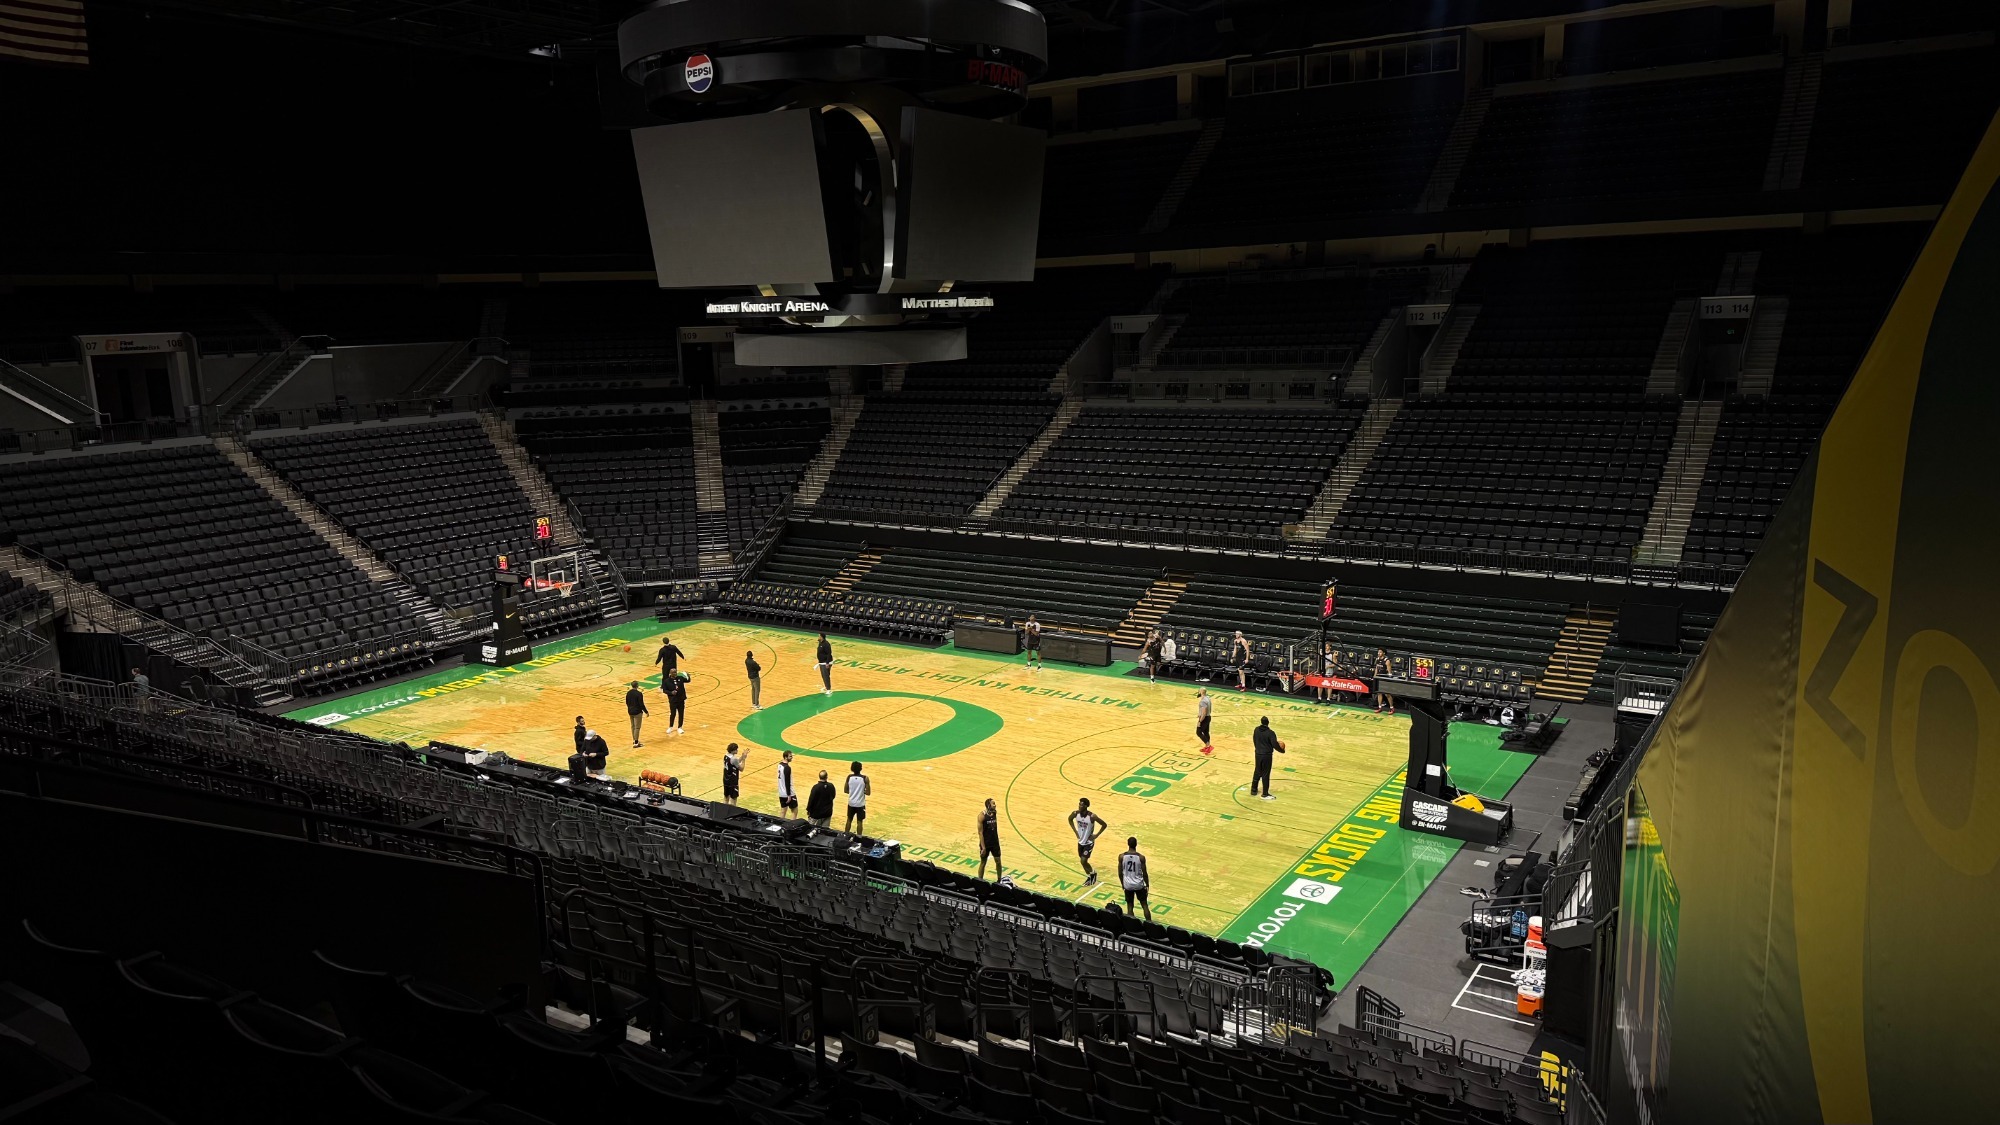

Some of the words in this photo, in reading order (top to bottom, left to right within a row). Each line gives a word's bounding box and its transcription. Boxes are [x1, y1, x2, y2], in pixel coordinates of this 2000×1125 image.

[687, 67, 711, 78] PEPSI
[741, 301, 783, 313] KNIGHT
[785, 300, 830, 312] ARENA
[1705, 304, 1722, 314] 113
[1732, 304, 1749, 313] 114
[1410, 312, 1425, 321] 112
[683, 332, 697, 340] 109
[833, 658, 913, 676] ARENA
[1416, 666, 1429, 678] 30
[349, 695, 421, 715] TOYOTA
[416, 665, 523, 698] MIGHTY
[523, 638, 631, 667] OREGON
[910, 670, 1010, 690] KNIGHT
[1012, 683, 1143, 710] MATTHEW
[1413, 801, 1448, 813] CASCADE
[899, 842, 980, 869] WOODS
[1294, 823, 1387, 882] DUCKS
[1127, 861, 1136, 872] 21
[1052, 879, 1084, 894] IN
[1239, 901, 1306, 948] TOYOTA
